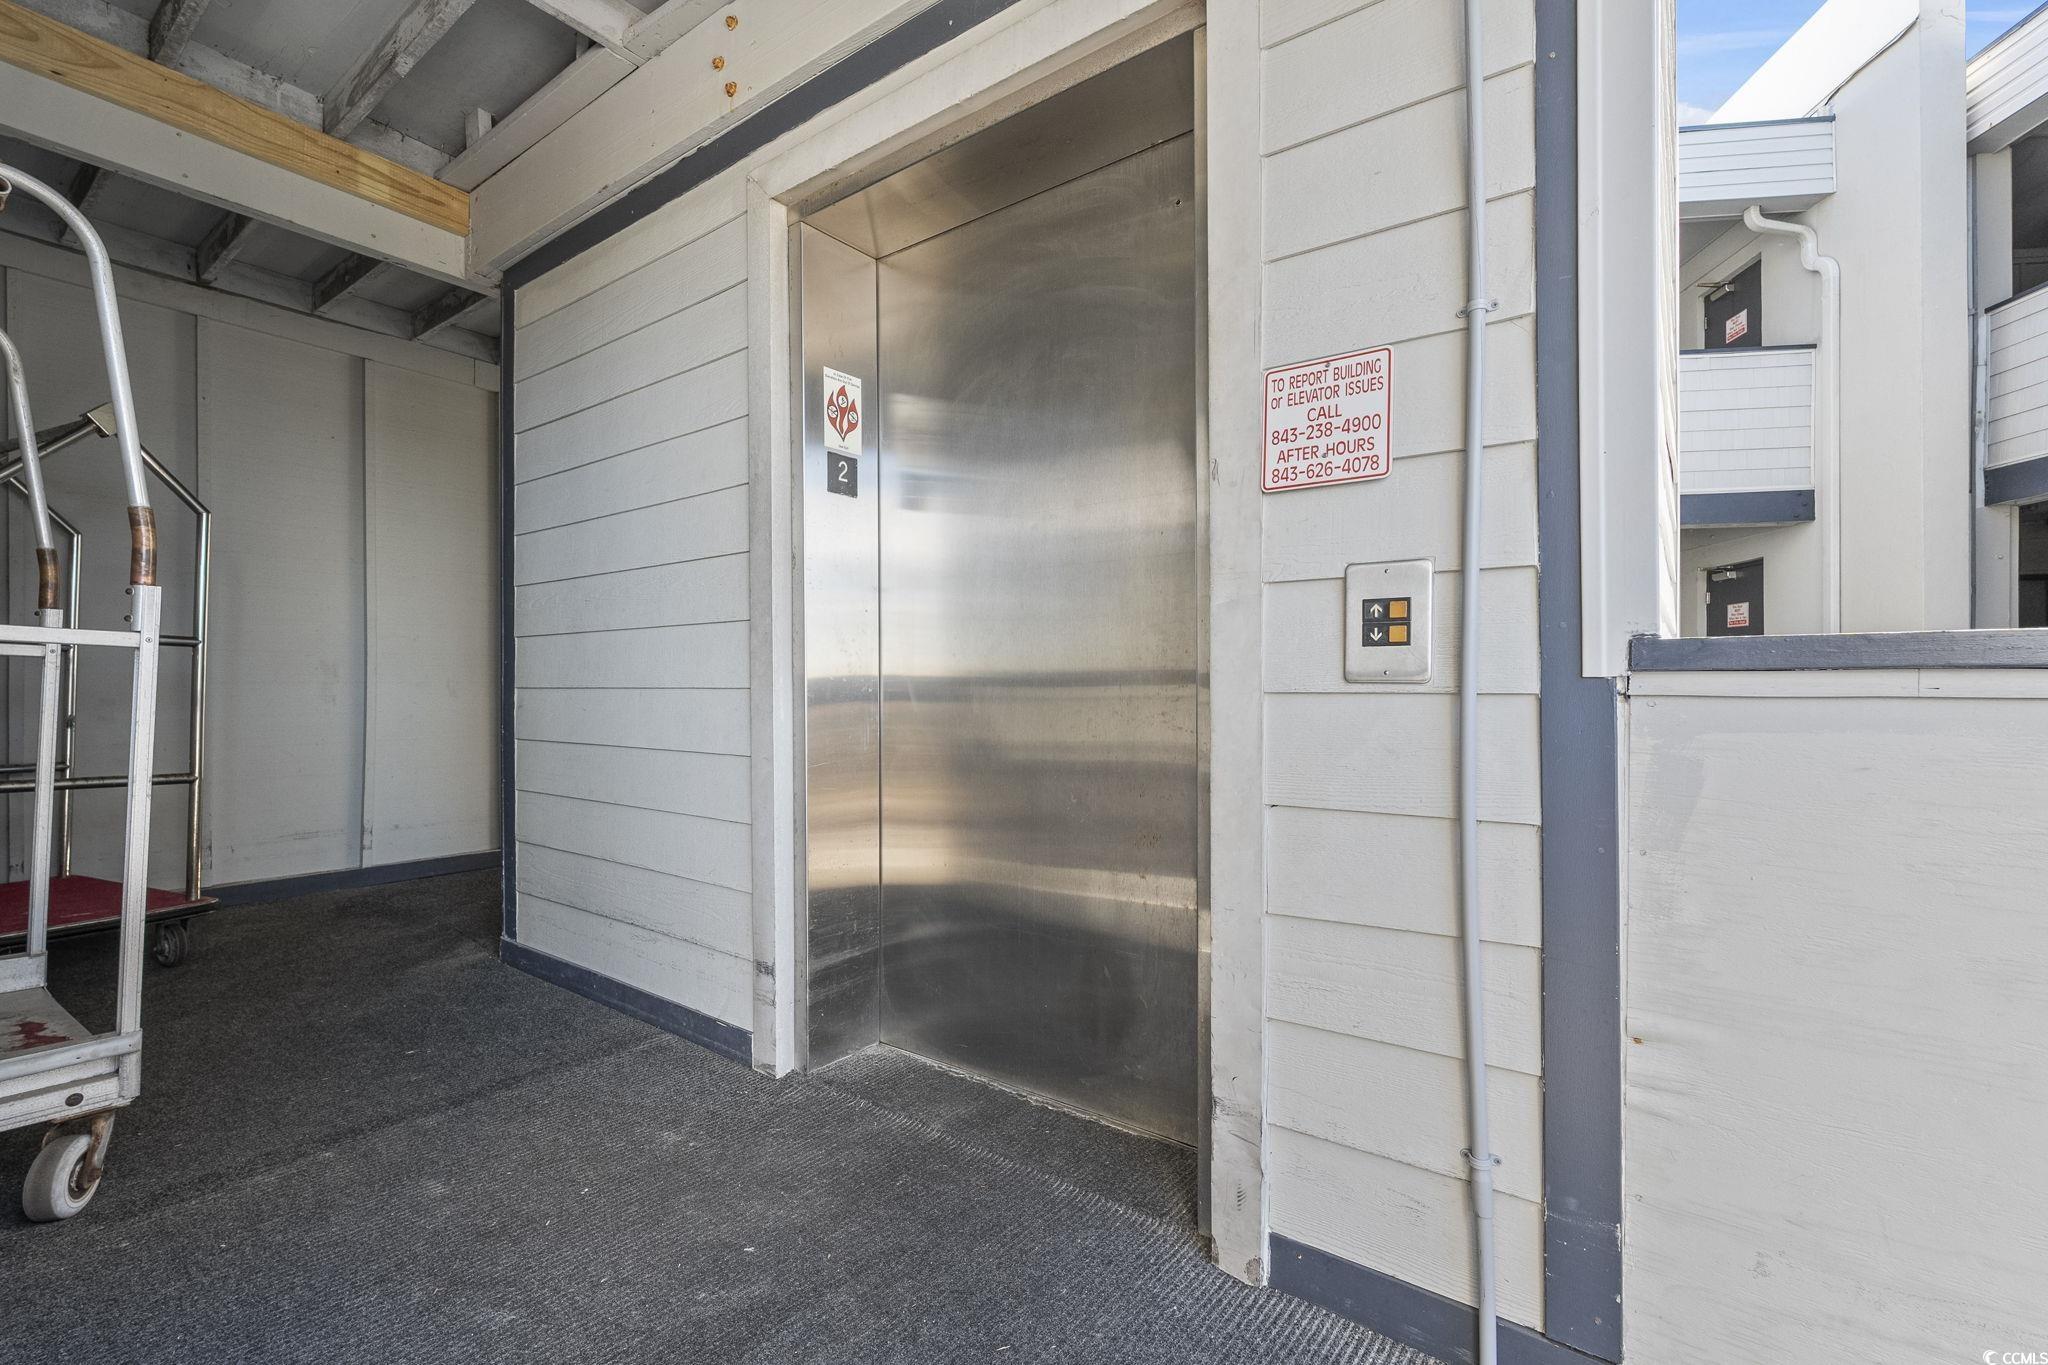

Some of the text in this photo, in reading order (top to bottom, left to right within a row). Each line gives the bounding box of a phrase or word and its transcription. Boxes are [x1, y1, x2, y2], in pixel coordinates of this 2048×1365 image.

[1272, 358, 1382, 393] TO REPORT BUILDING
[1271, 376, 1384, 410] or ELEVATOR ISSUES
[1307, 404, 1342, 422] CALL
[1271, 413, 1382, 445] 843-238-4900
[1276, 436, 1375, 464] AFTER HOURS
[838, 461, 848, 482] 2
[1271, 454, 1380, 484] 843-626-4078
